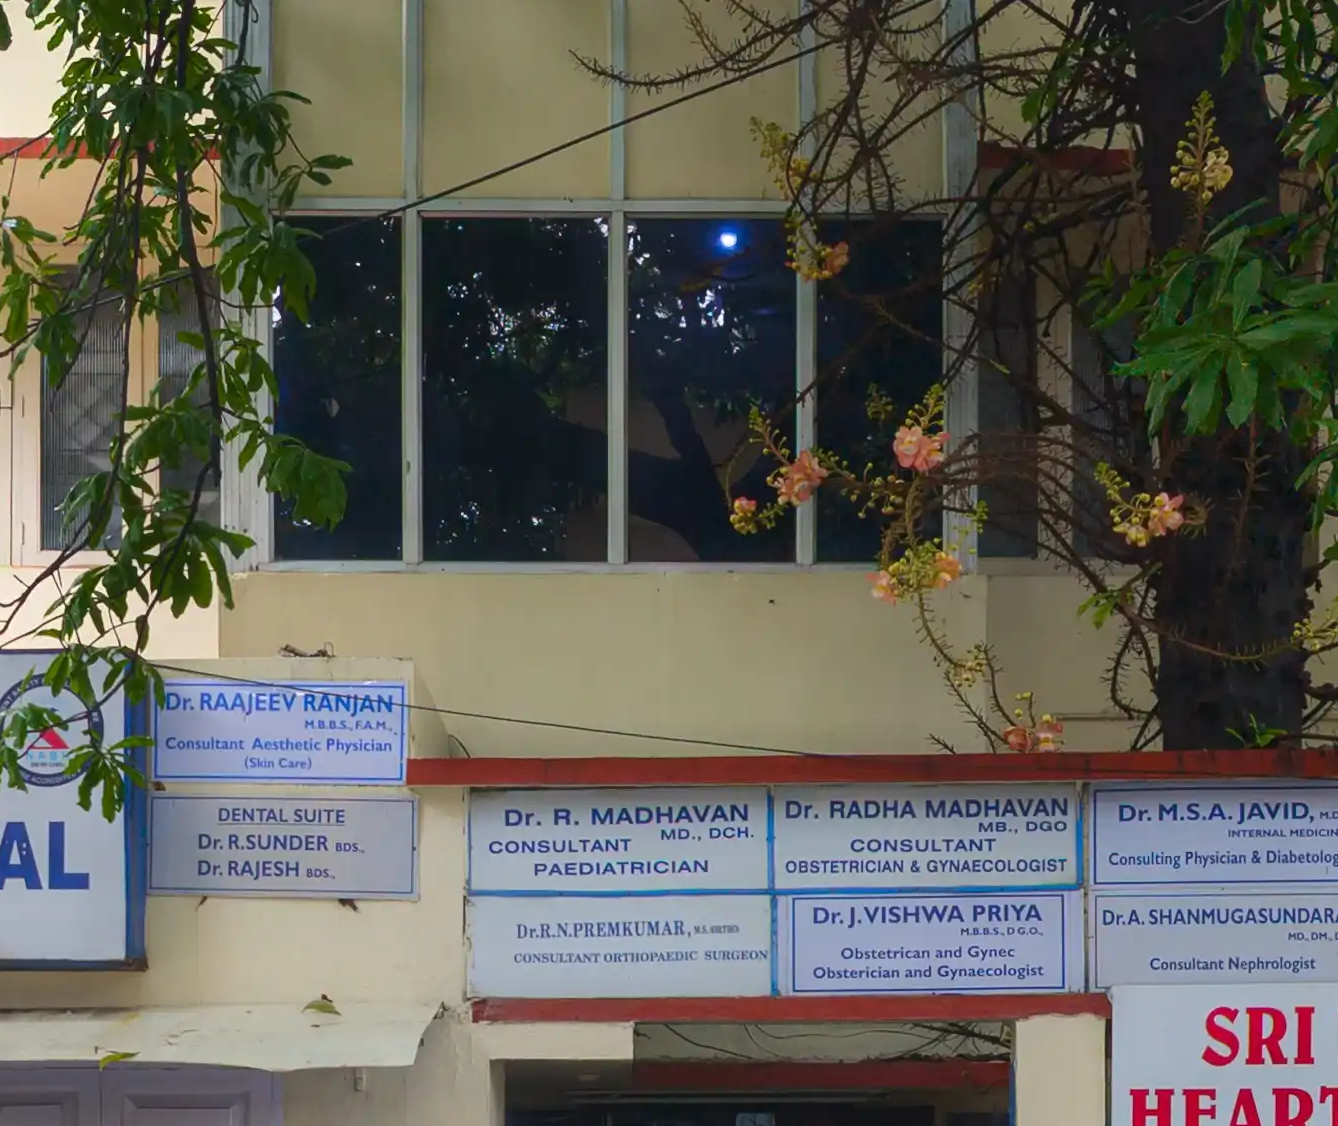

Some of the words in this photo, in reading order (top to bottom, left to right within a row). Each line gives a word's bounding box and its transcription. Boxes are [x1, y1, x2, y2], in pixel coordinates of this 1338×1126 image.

[166, 693, 194, 711] Dr.
[200, 693, 297, 717] RAAJEEV
[303, 693, 394, 717] RANJAN
[165, 737, 244, 750] Consultant
[251, 738, 321, 751] Aesthetic
[326, 738, 393, 755] Physician
[244, 757, 275, 769] (Skin
[278, 757, 313, 770] Care)
[217, 808, 289, 823] DENTAL
[293, 809, 346, 823] SUITE
[504, 807, 542, 828] Dr.
[554, 807, 580, 827] R.
[591, 804, 750, 825] MADHAVAN
[785, 801, 821, 821] Dr.
[829, 800, 917, 820] RADHA
[925, 798, 1069, 818] MADHAVAN
[1118, 803, 1153, 823] Dr.
[1158, 803, 1233, 822] M.S.A.
[1237, 801, 1315, 824] JAVID,
[661, 828, 702, 842] MD.,
[709, 826, 755, 840] DCH.
[1025, 820, 1068, 833] DGO
[1227, 828, 1286, 838] INTERNAL
[197, 834, 224, 851] Dr.
[228, 835, 328, 852] R.SUNDER
[489, 838, 632, 854] CONSULTANT
[850, 838, 997, 854] CONSULTANT
[534, 859, 710, 876] PAEDIATRICIAN
[785, 859, 904, 875] OBSTETRICIAN
[910, 860, 921, 874] &
[926, 858, 1067, 874] GYNAECOLOGIST
[1108, 851, 1181, 868] Consulting
[1185, 850, 1248, 868] Physician
[1251, 851, 1262, 864] &
[197, 860, 223, 876] Dr.
[228, 861, 300, 880] RAJESH
[972, 903, 1043, 922] PRIYA
[514, 952, 600, 964] CONSULTANT
[603, 950, 698, 963] ORTHOPAEDIC
[704, 949, 769, 962] SURGEON
[840, 946, 931, 960] Obstetrican
[935, 946, 962, 960] and
[967, 945, 1016, 962] Gynec
[813, 965, 901, 980] Obsterician
[904, 965, 932, 979] and
[936, 963, 1045, 982] Gynaecologist
[1150, 956, 1224, 971] Consultant
[1228, 956, 1316, 973] Nephrologist
[1201, 1006, 1316, 1067] SRI
